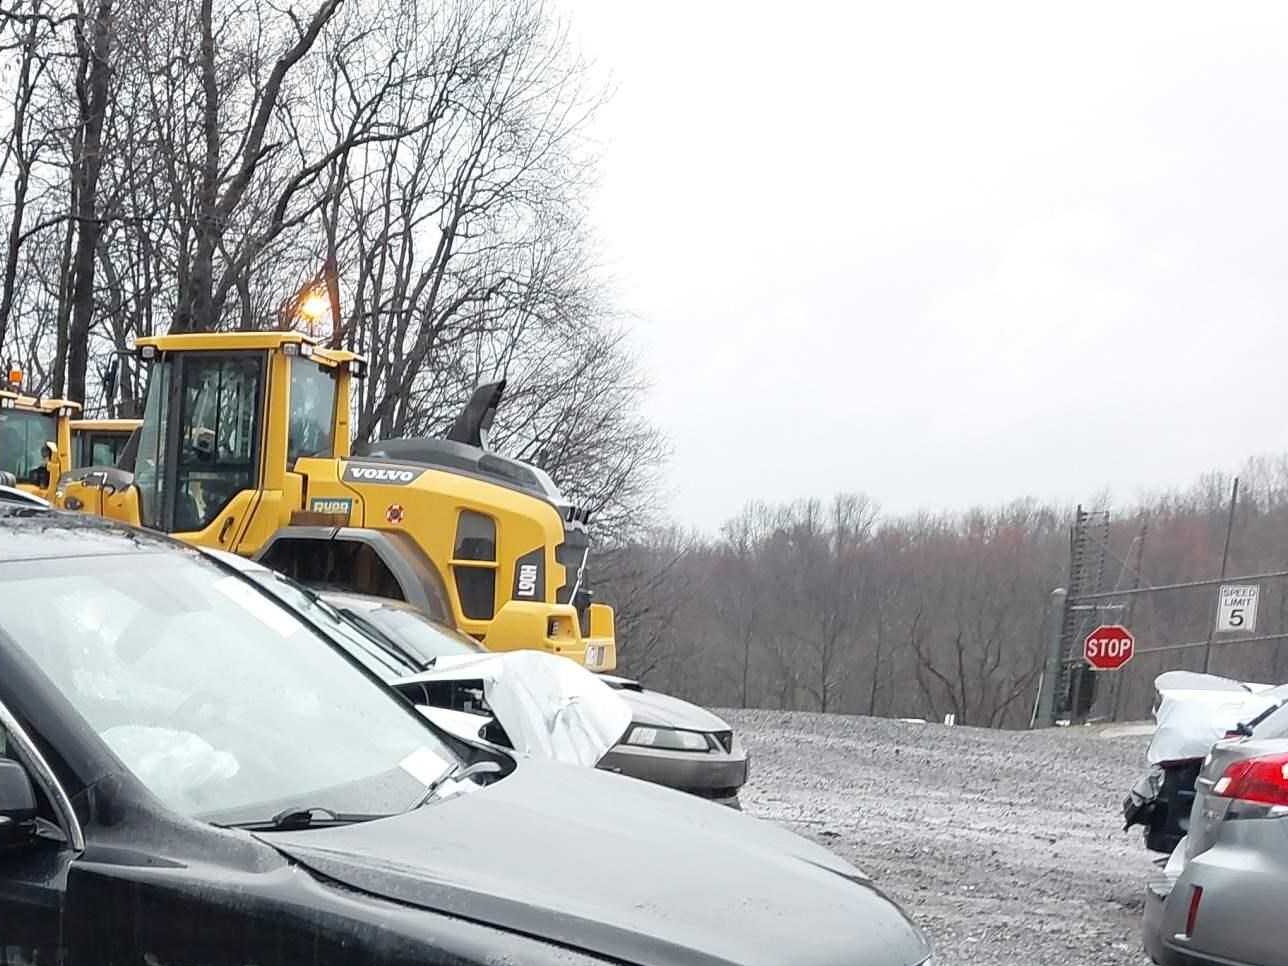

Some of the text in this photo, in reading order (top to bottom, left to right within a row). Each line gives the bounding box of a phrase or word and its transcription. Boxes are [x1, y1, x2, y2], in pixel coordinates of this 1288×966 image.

[351, 467, 414, 481] VOLVO
[518, 564, 537, 596] L90H
[1229, 609, 1244, 626] 5
[1087, 638, 1131, 657] STOP
